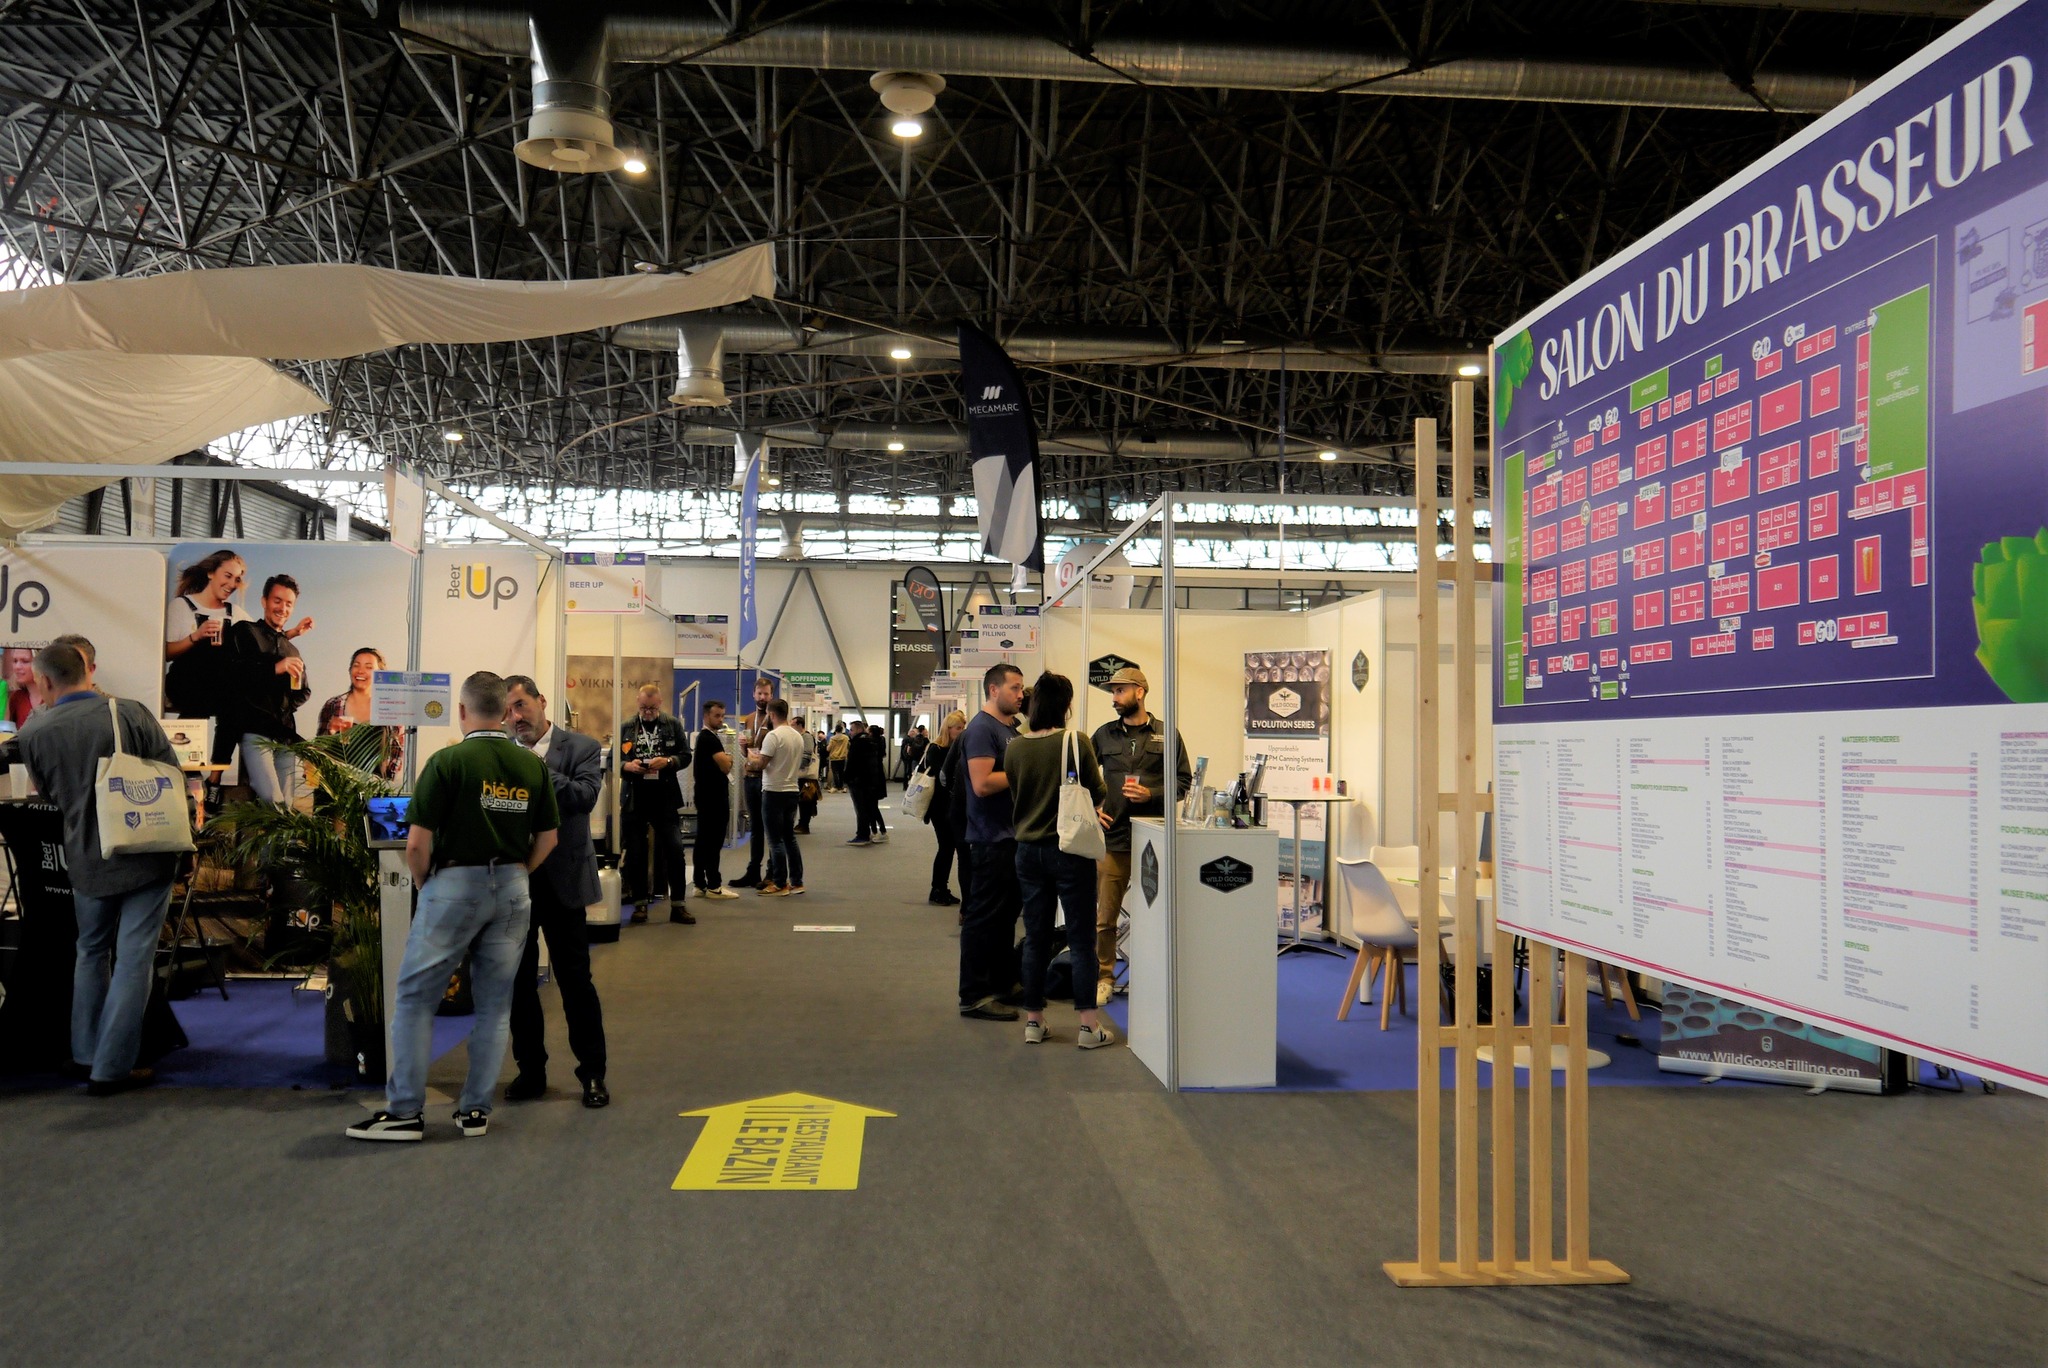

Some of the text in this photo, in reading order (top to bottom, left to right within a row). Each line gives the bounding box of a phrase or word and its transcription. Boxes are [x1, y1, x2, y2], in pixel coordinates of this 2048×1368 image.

[1540, 55, 2035, 401] SALON DU BRASSEUR
[1822, 335, 1832, 345] E57
[1886, 365, 1910, 381] ESPACE
[1892, 379, 1902, 390] DE
[968, 403, 1020, 415] MECAMARC
[1871, 462, 1894, 475] SORTIE
[1859, 496, 1870, 506] B61
[1914, 536, 1926, 547] B66
[447, 563, 519, 610] Beer Up
[1869, 621, 1880, 631] A64
[893, 643, 936, 653] BRASSE
[1089, 675, 1109, 683] WILD
[1252, 720, 1316, 729] EVOLUTION SERIES
[1279, 755, 1301, 763] Canning
[1301, 755, 1324, 763] Systems
[495, 800, 523, 809] appro
[42, 841, 54, 871] Beer
[2001, 889, 2048, 902] MUSEE FRANC
[1678, 1049, 1861, 1078] www.WildGooseFilling.com
[780, 1117, 831, 1185] RESTAURANT
